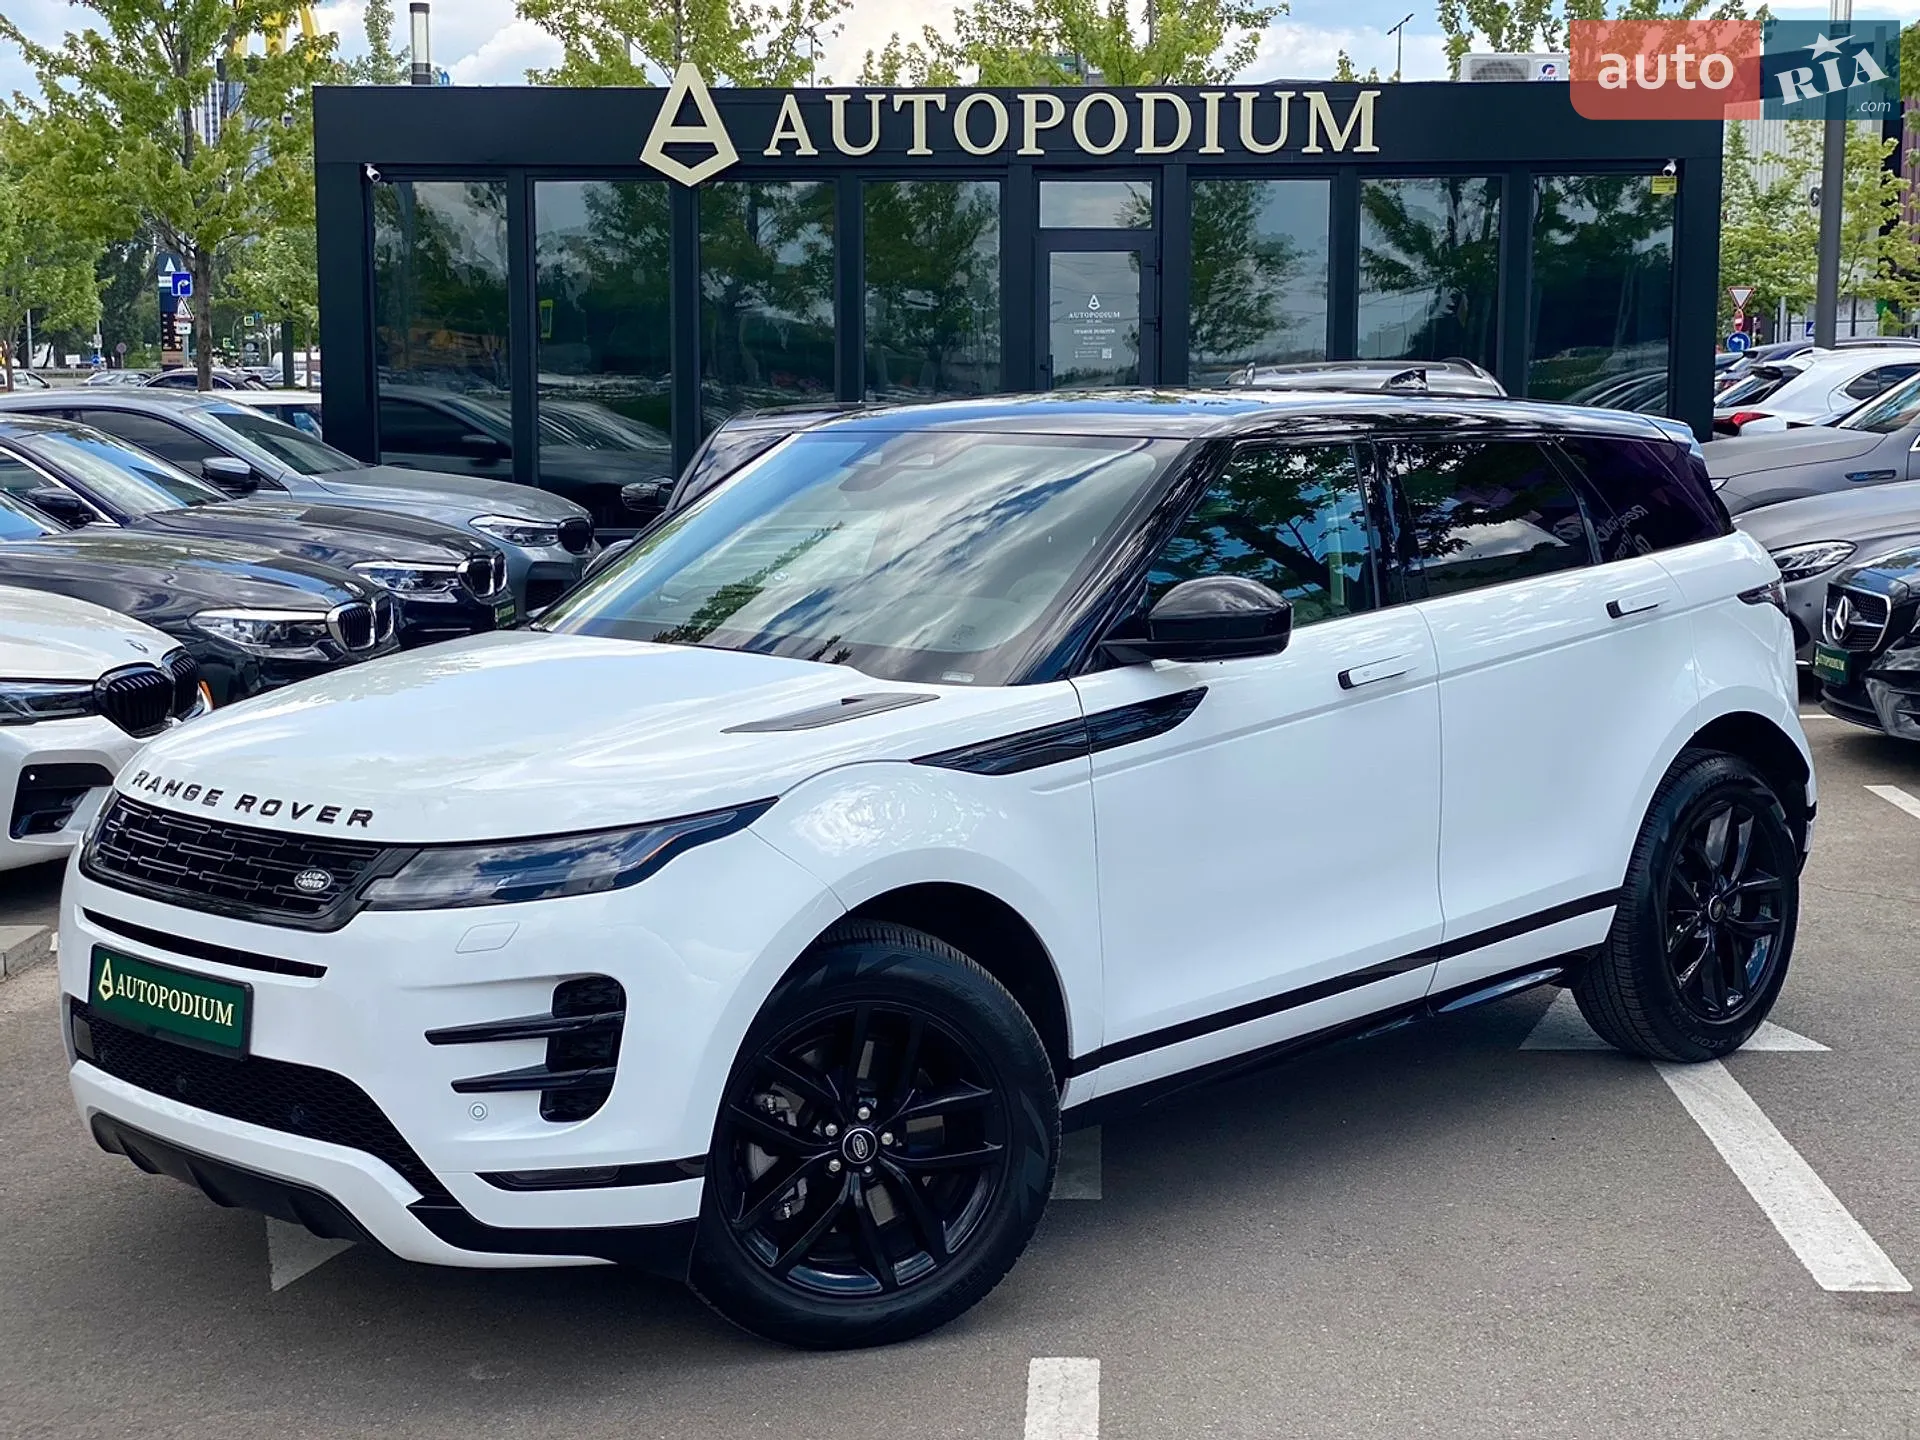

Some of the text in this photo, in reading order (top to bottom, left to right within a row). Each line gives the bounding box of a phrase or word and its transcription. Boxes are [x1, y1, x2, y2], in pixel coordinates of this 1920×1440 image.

[763, 90, 1382, 157] AUTOPODIUM
[131, 769, 374, 828] RANGE ROVER
[115, 973, 234, 1027] AUTOPODIUM
